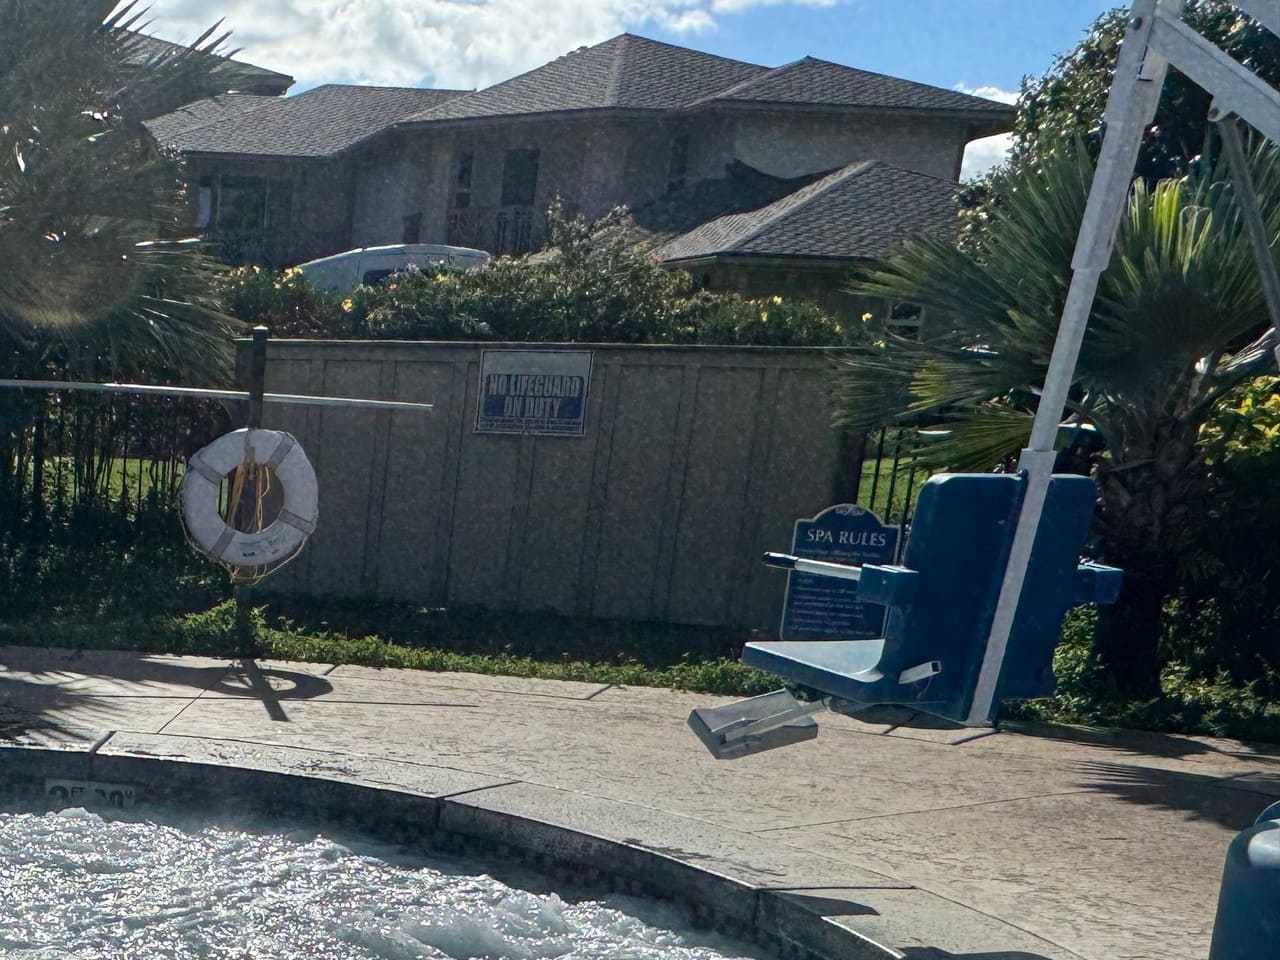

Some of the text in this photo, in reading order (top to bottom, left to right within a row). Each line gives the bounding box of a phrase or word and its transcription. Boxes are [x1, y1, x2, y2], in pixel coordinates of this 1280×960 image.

[489, 374, 581, 398] NO LIFEGUARD
[503, 396, 562, 418] ON DUTY
[807, 528, 887, 547] SPA RULES
